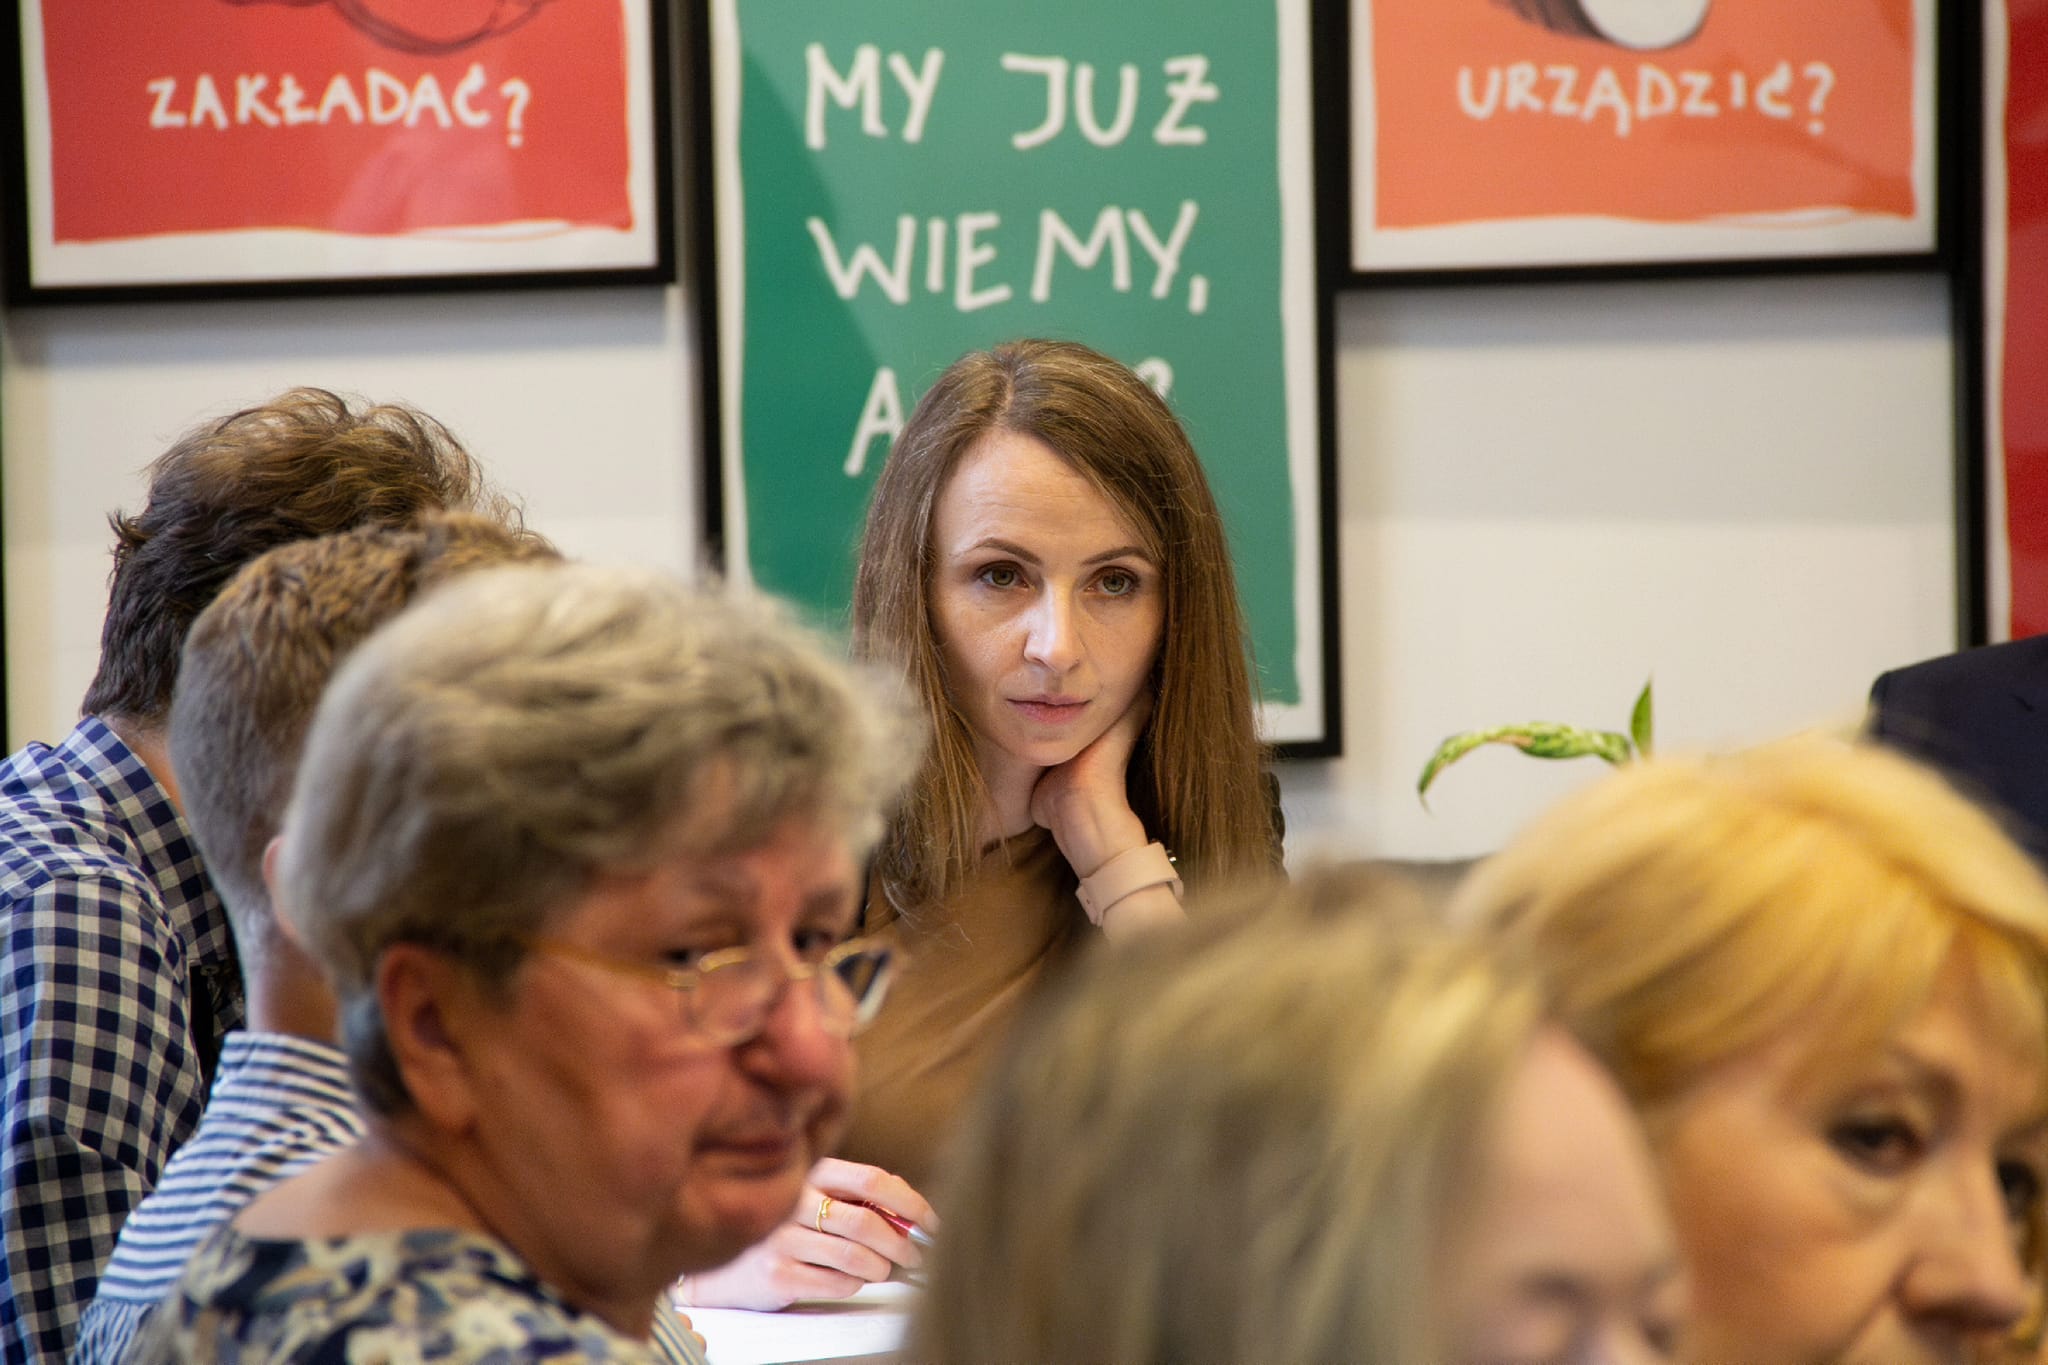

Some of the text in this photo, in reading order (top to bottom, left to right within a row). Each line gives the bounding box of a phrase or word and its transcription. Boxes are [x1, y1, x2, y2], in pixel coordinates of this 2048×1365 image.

[148, 63, 531, 148] ZAKŁADAĆ?
[804, 41, 946, 151] MY
[1456, 60, 1835, 136] URZĄDZIĆ?
[806, 200, 1209, 315] WIEMY,
